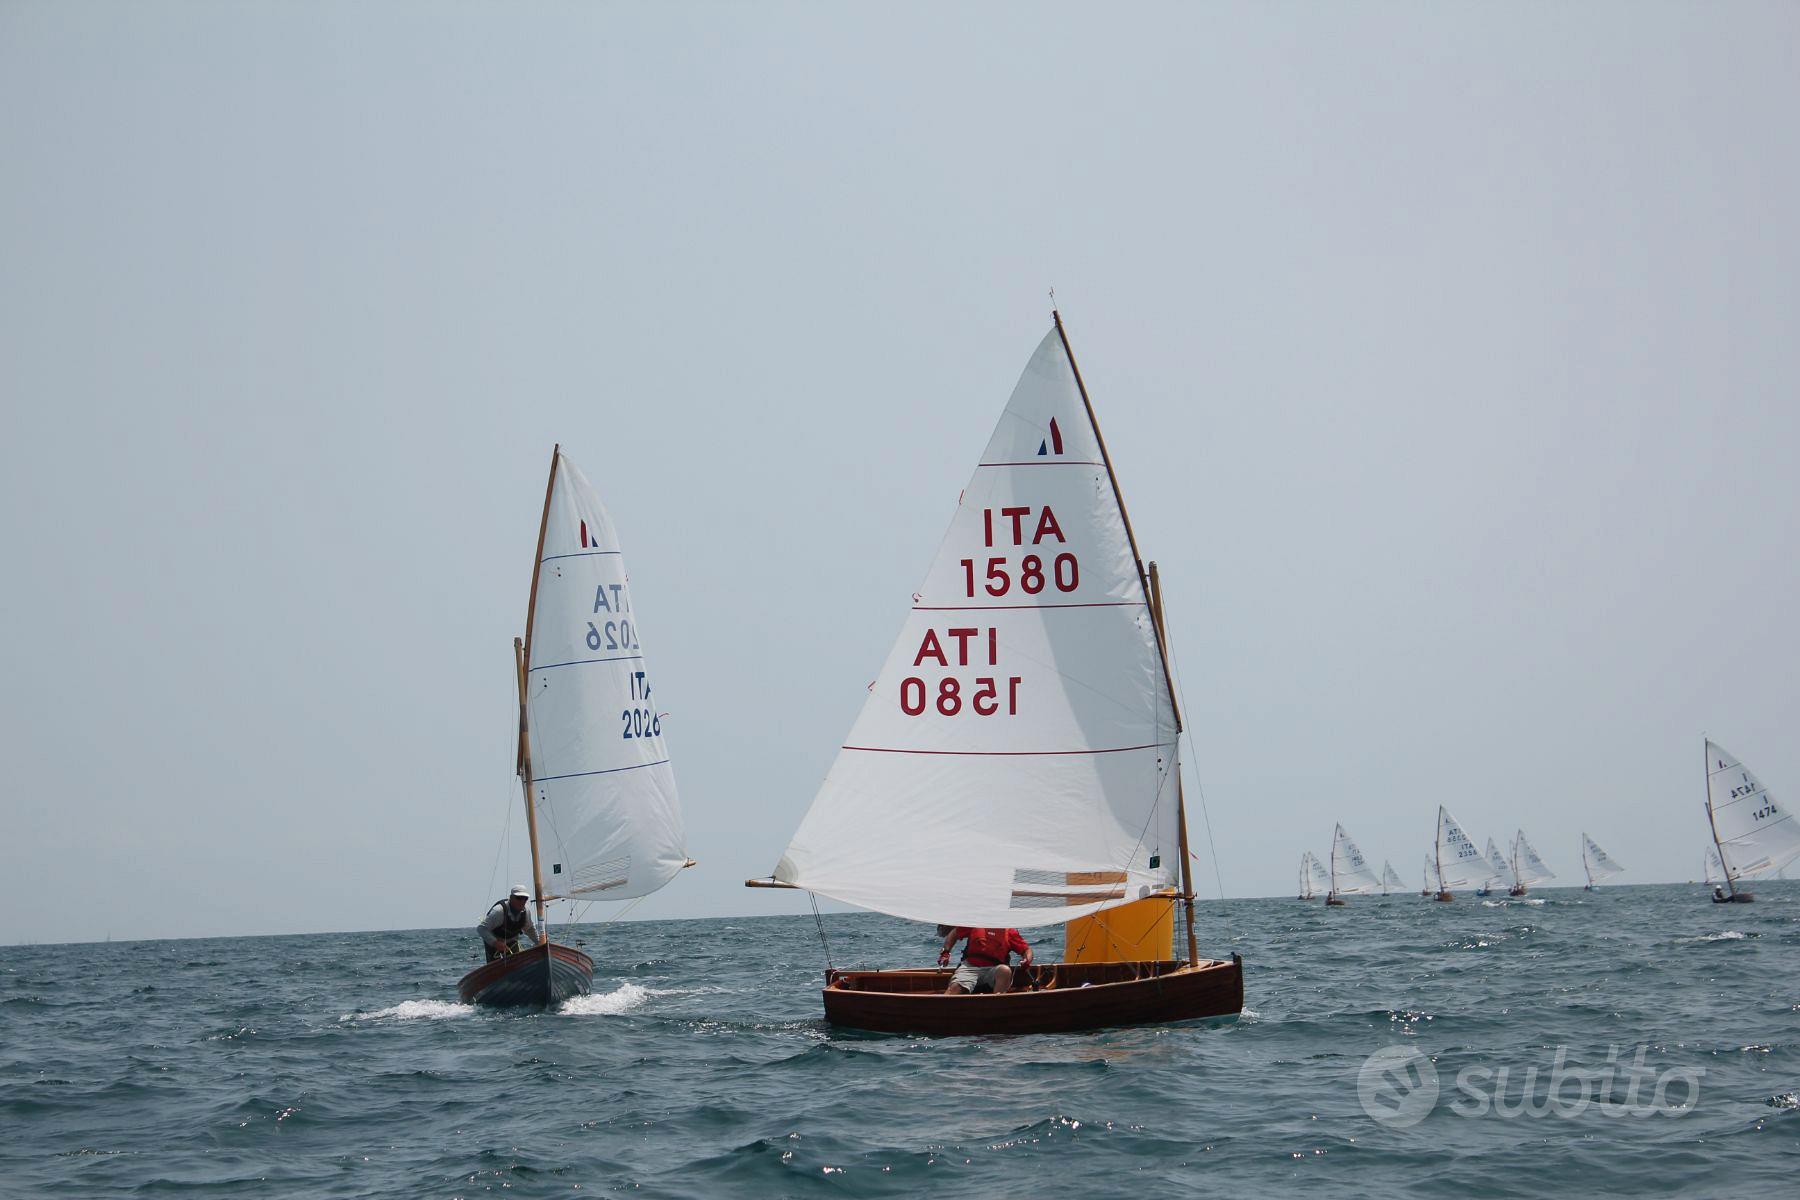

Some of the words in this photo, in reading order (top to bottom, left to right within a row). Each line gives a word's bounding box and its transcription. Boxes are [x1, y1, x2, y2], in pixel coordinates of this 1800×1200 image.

[984, 506, 1064, 547] ITA
[960, 553, 1080, 598] 1580
[622, 708, 661, 739] 2026
[1752, 805, 1777, 821] 1474
[1461, 842, 1475, 850] ITA
